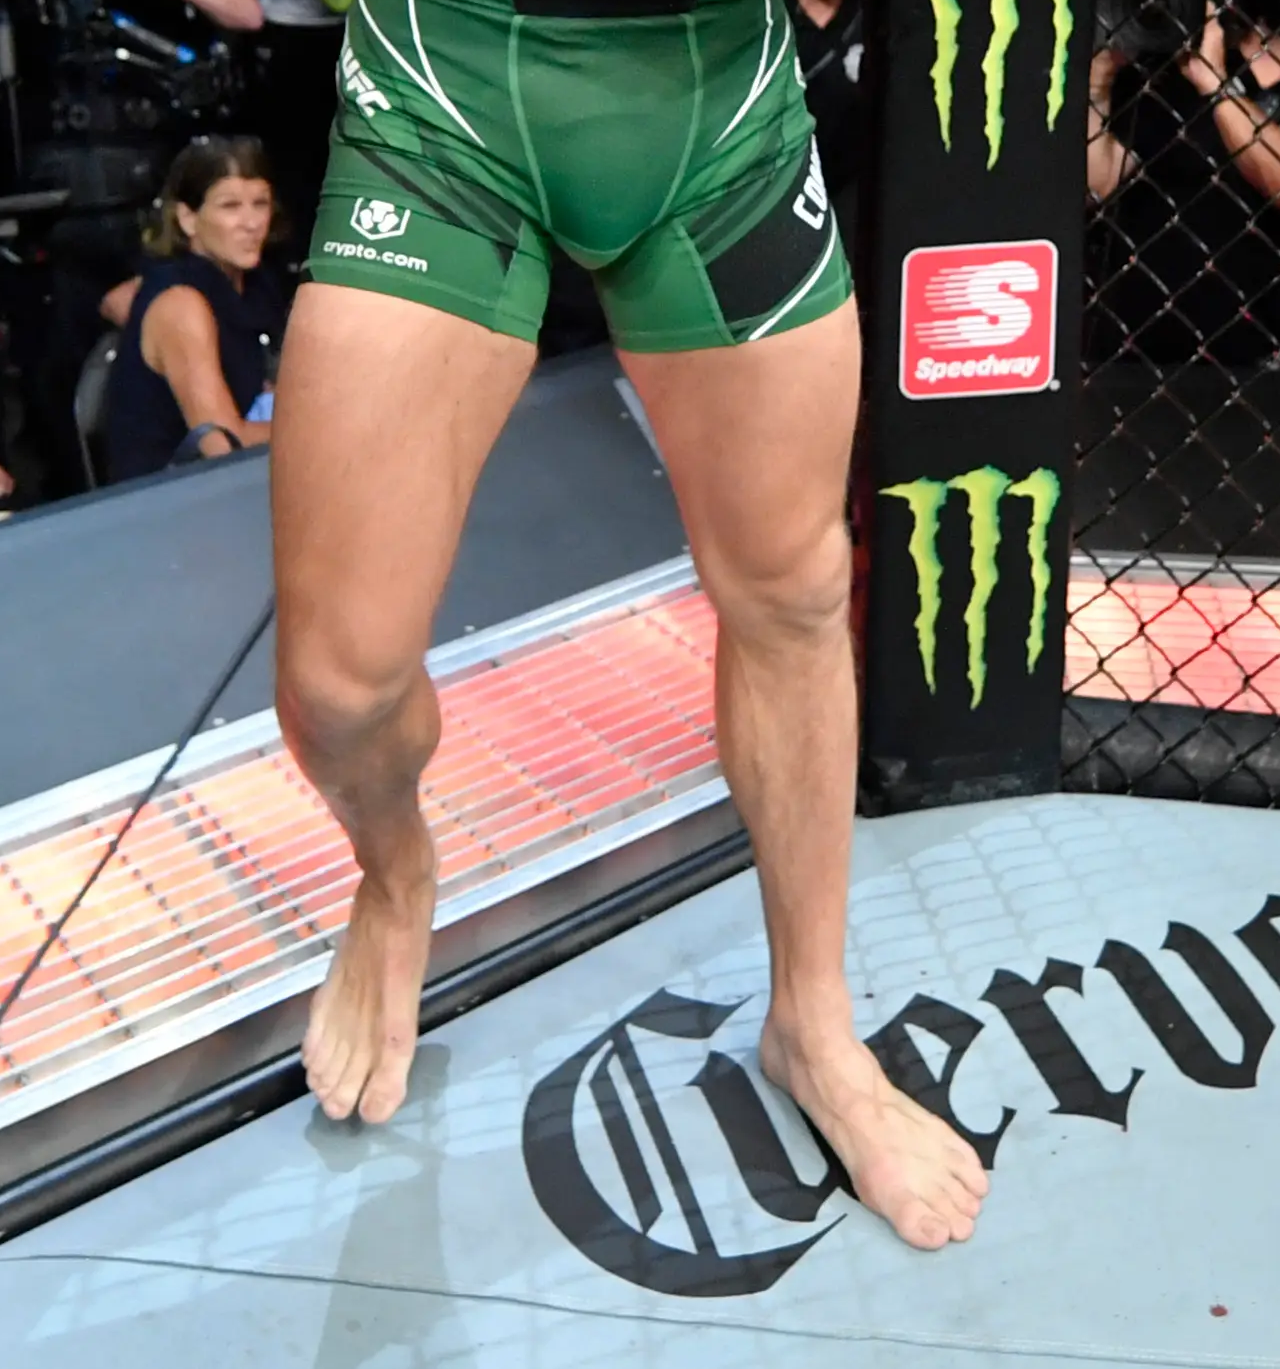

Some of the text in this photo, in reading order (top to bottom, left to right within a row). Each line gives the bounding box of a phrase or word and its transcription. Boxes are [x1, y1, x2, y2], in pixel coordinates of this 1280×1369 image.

[340, 45, 392, 119] UFC
[323, 240, 428, 273] crypto.com
[914, 353, 1041, 385] Speedway
